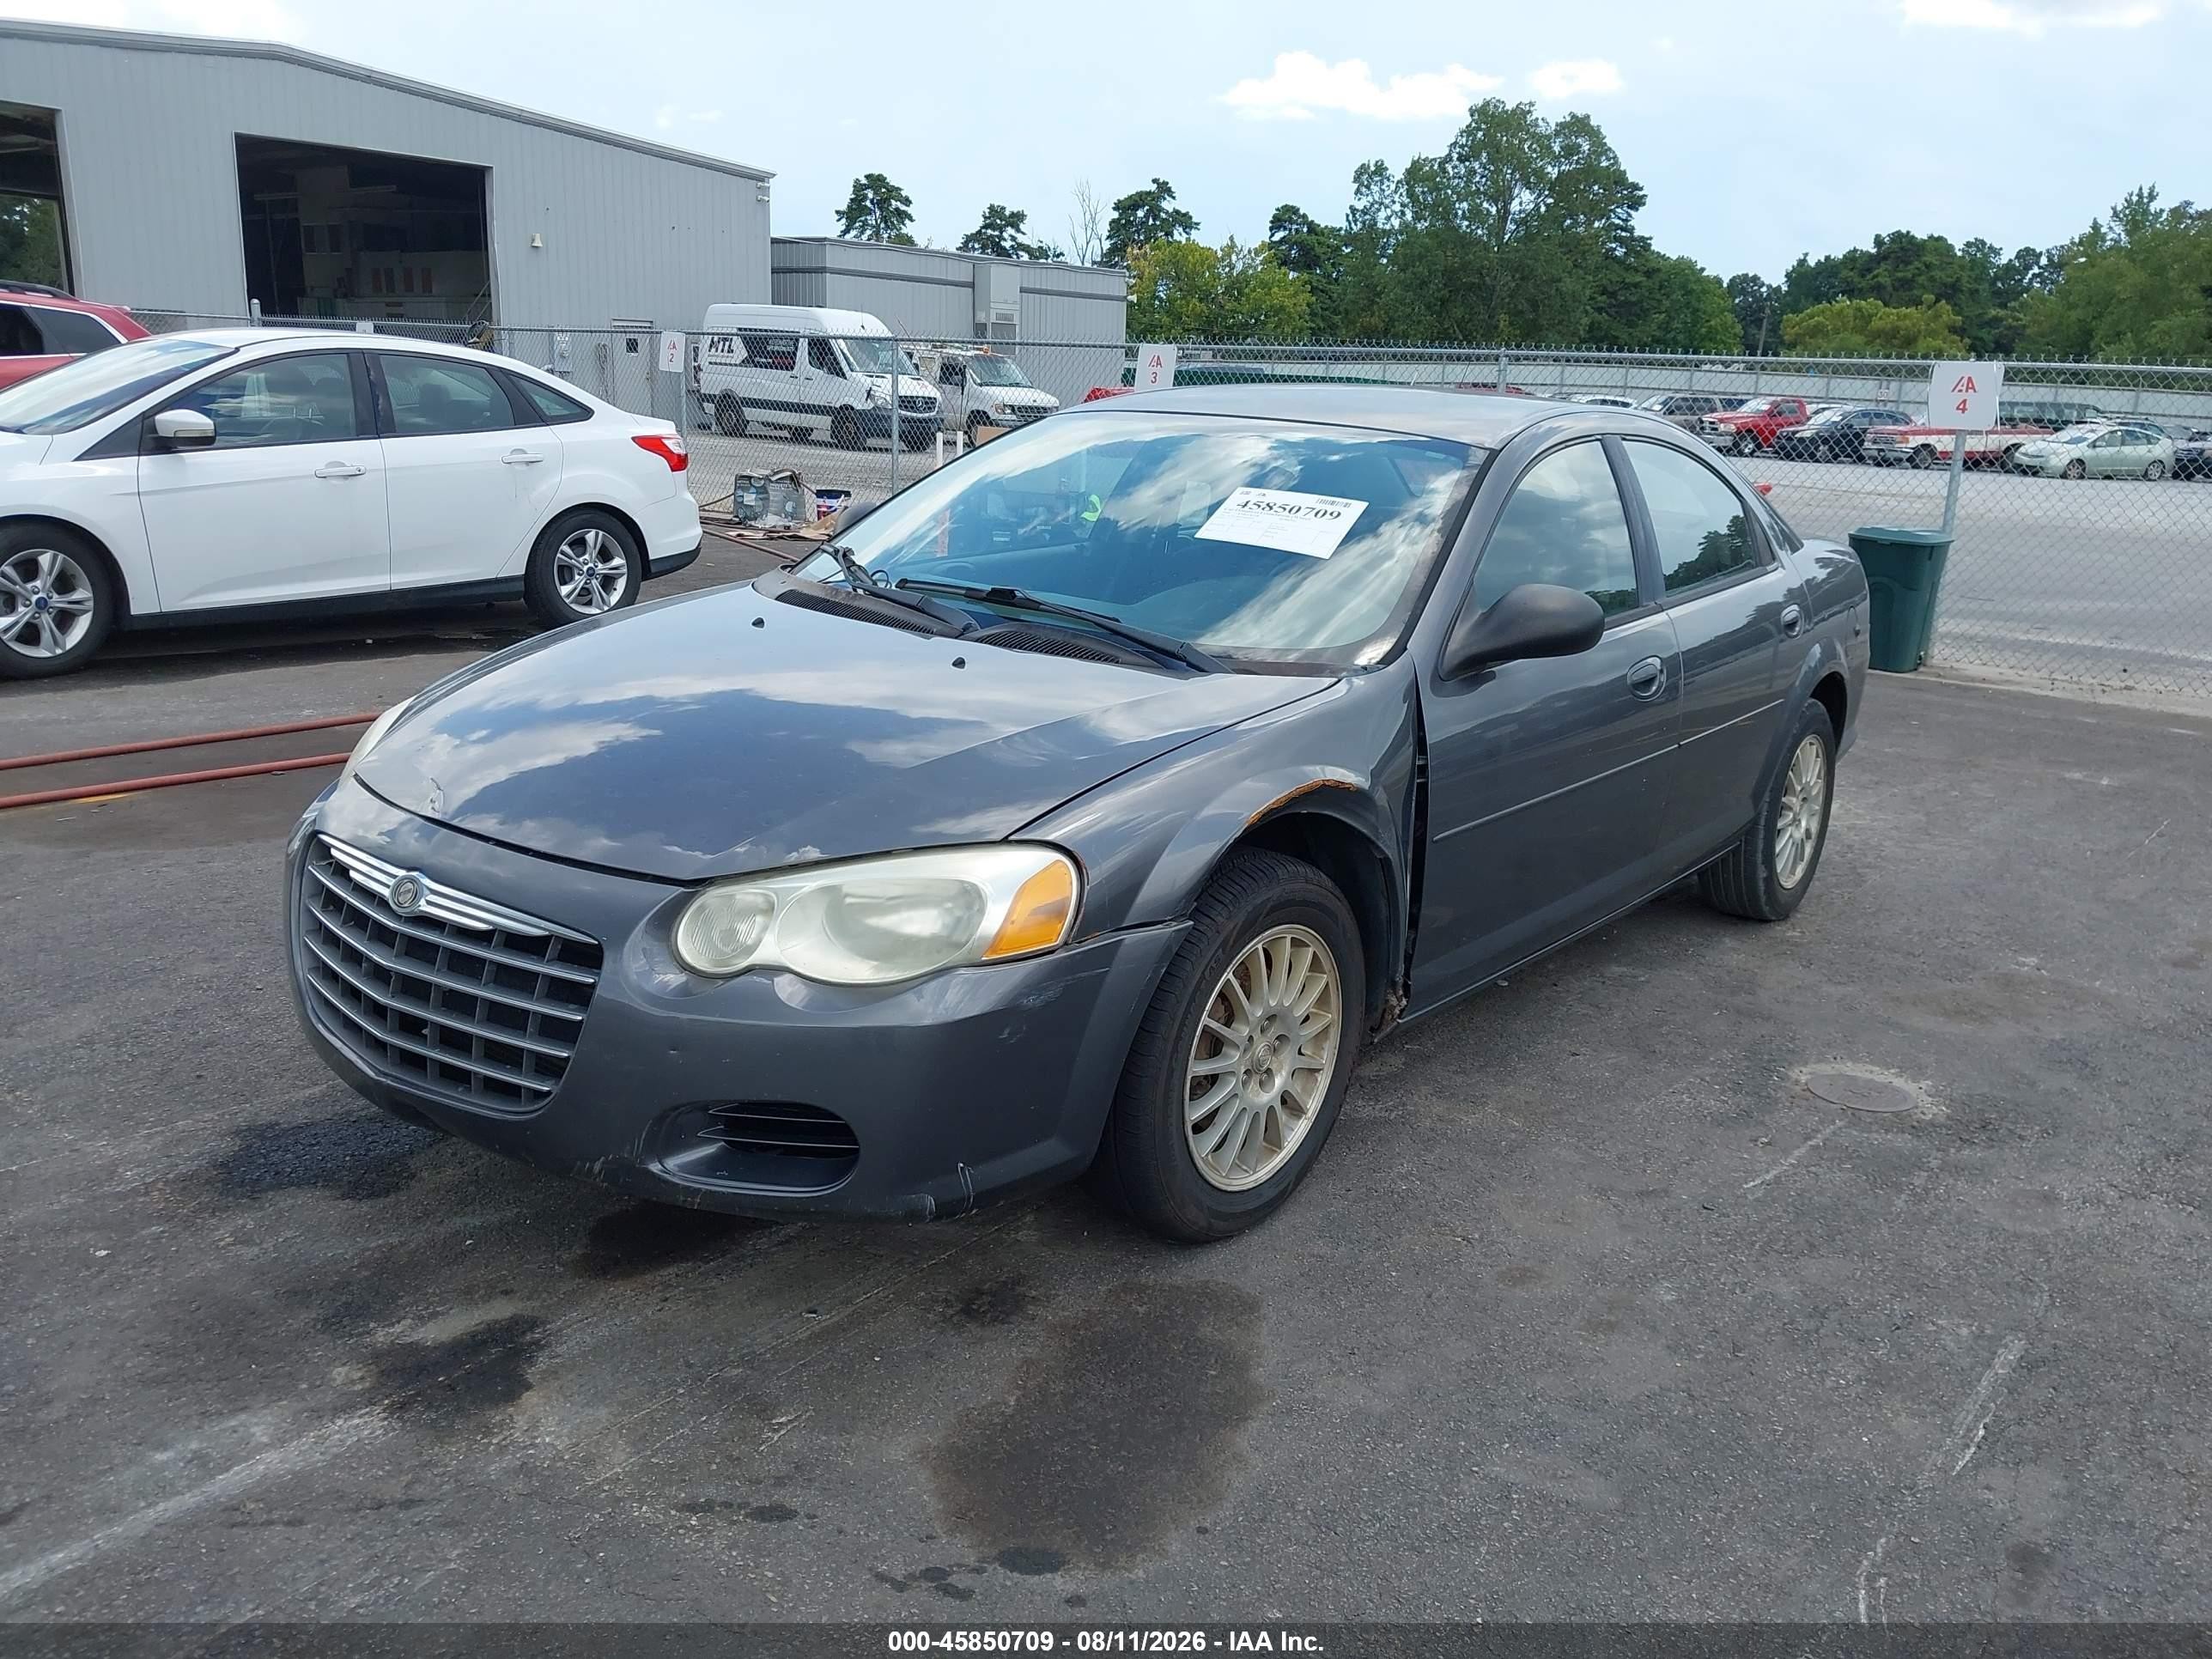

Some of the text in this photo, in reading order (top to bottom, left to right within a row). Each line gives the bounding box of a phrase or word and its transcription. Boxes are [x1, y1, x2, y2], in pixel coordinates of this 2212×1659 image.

[708, 336, 734, 354] MTL
[669, 353, 674, 363] 2
[1151, 371, 1158, 384] 3
[1955, 398, 1968, 414] 4
[1236, 500, 1341, 520] 45850709
